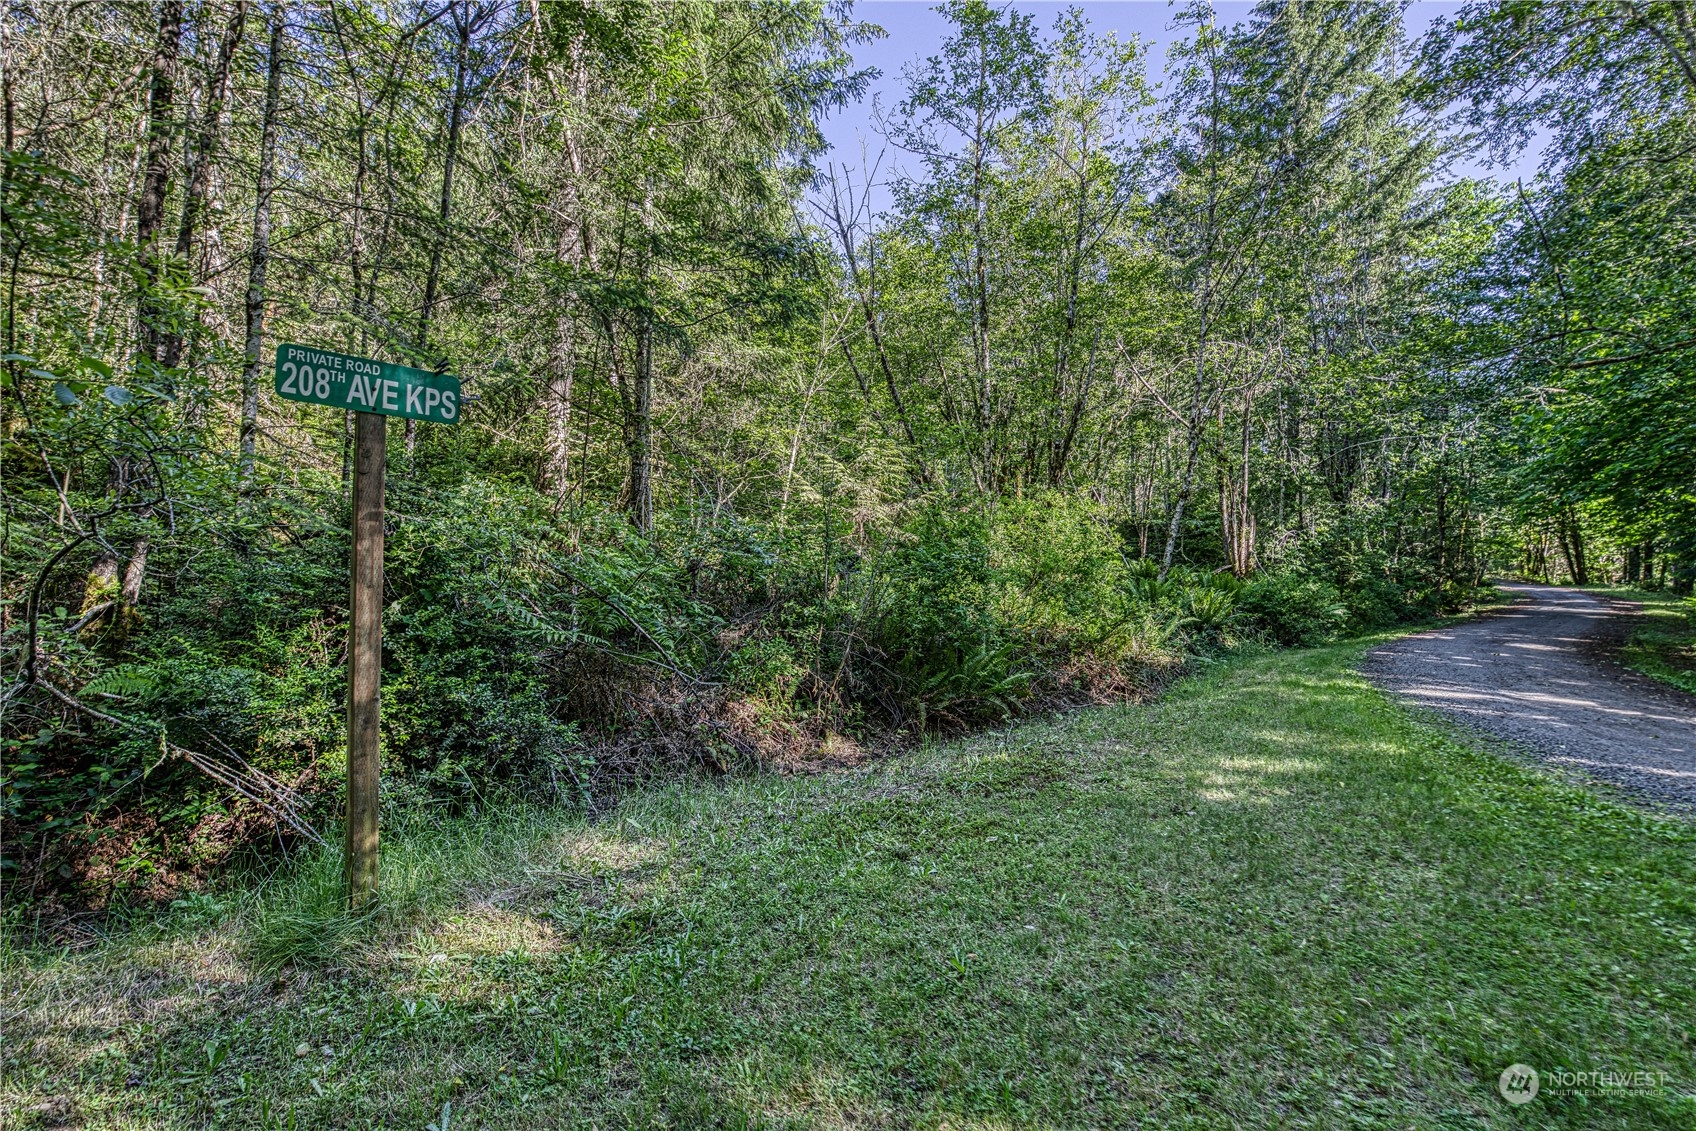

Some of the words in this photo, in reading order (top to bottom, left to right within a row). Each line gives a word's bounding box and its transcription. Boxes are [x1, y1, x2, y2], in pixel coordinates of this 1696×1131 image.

[288, 348, 342, 368] PRIVATE
[345, 359, 380, 376] ROAD
[280, 362, 346, 399] 208TH
[346, 374, 399, 411] AVE
[405, 383, 456, 420] KPS
